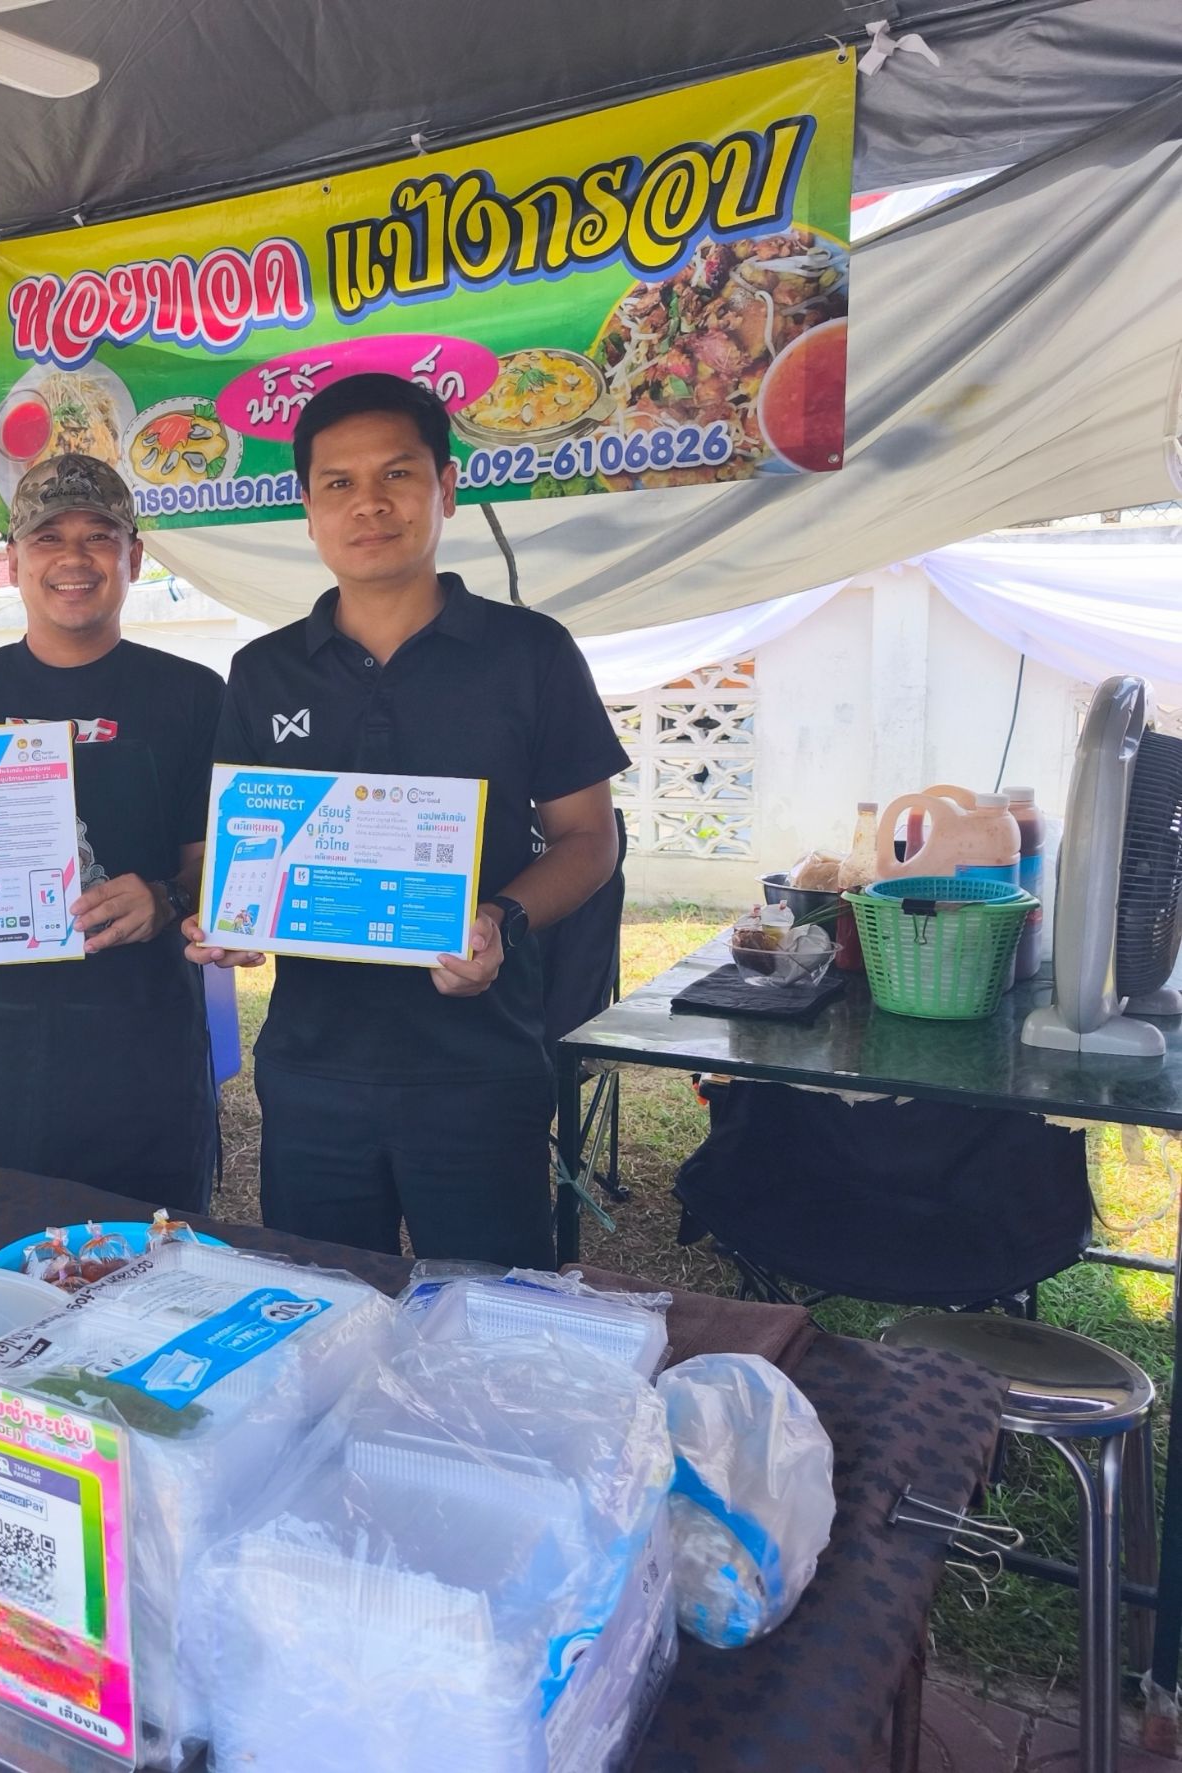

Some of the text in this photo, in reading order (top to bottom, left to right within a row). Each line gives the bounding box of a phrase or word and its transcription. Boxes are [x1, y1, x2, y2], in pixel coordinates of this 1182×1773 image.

[14, 117, 810, 362] หอยทอด แป้งกรอบ
[239, 783, 293, 796] CLICK TO
[246, 797, 305, 811] CONNECT
[318, 804, 352, 822] เรียนรู้
[306, 822, 314, 836] ดู
[318, 818, 344, 834] เที่ยว
[315, 835, 349, 851] ทั่วไทย
[13, 1462, 41, 1478] THAI QR
[13, 1471, 42, 1485] PAYMENT
